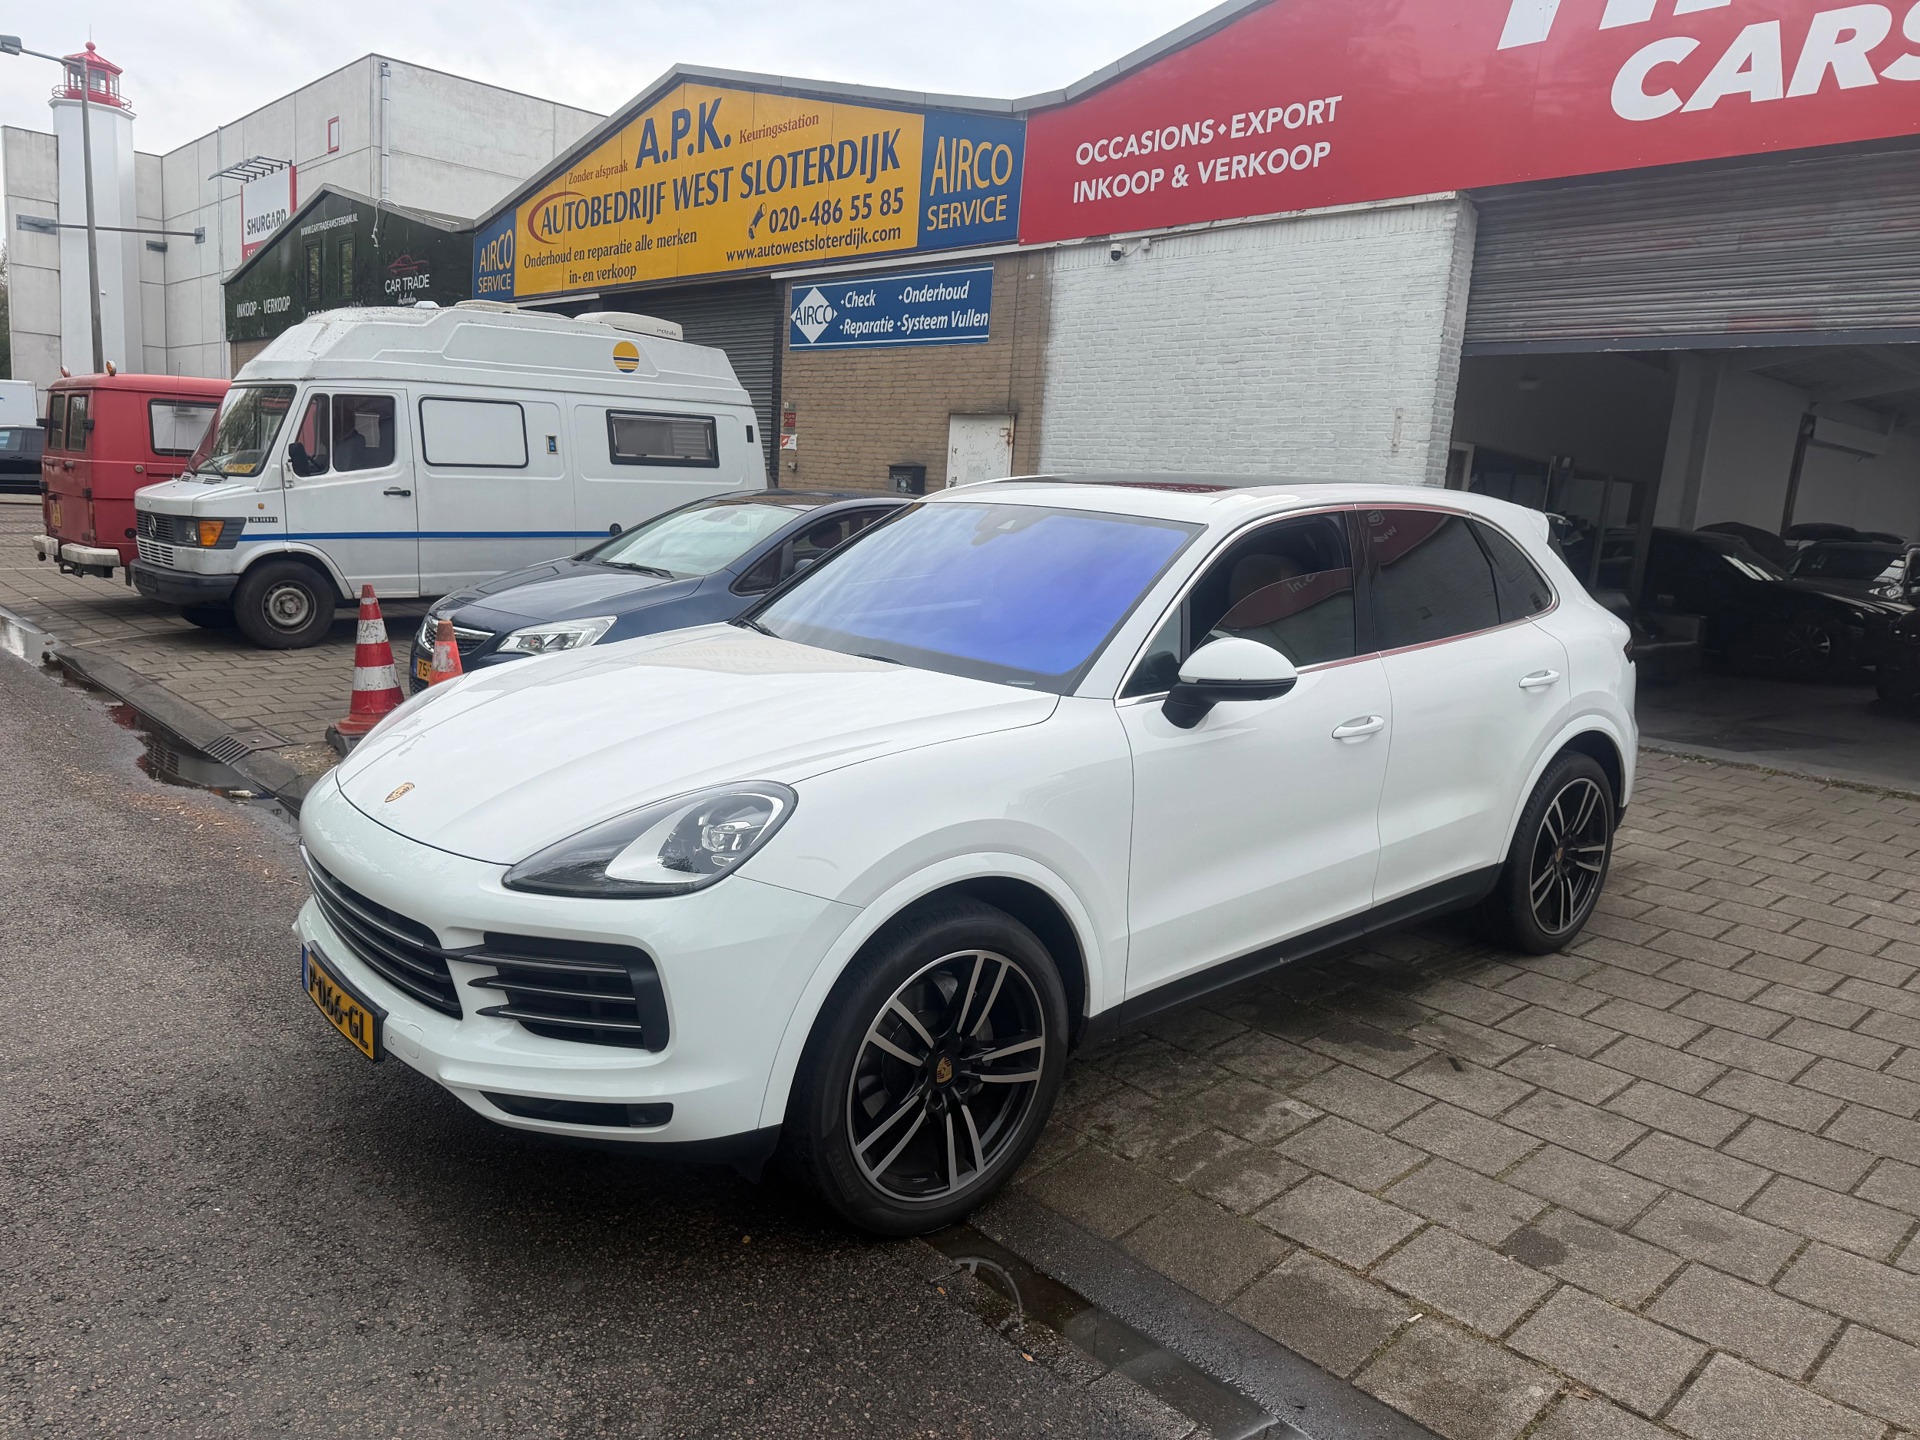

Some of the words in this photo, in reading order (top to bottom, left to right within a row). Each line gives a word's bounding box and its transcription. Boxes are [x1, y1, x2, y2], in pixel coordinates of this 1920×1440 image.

[635, 97, 732, 169] A.P.K.
[739, 114, 819, 144] Keuringsstation
[1075, 118, 1215, 166] OCCASIONS
[1230, 95, 1343, 139] EXPORT
[568, 167, 593, 185] Zonder
[595, 159, 628, 180] afspraak
[929, 136, 1013, 197] AIRCO
[1073, 168, 1165, 204] INKOOP
[1171, 164, 1189, 189] &
[1197, 141, 1331, 184] VERKOOP
[540, 181, 666, 237] AUTOBEDRIJF
[673, 167, 734, 211] WEST
[740, 128, 901, 199] SLOTERDIJK
[246, 208, 287, 236] SHURGARD
[769, 198, 843, 234] 020-486
[849, 193, 873, 221] 55
[879, 187, 904, 216] 85
[926, 194, 1008, 231] SERVICE
[479, 229, 514, 274] AIRCO
[524, 247, 572, 269] Onderhoud
[574, 249, 585, 261] en
[587, 240, 632, 262] reparatie
[635, 234, 653, 252] alle
[656, 228, 698, 249] merken
[726, 227, 901, 262] www.autowestsloterdijk.com
[385, 279, 401, 293] CAR
[402, 273, 430, 290] TRADE
[478, 273, 512, 294] SERVICE
[596, 264, 637, 281] verkoop
[845, 289, 877, 308] Check
[903, 280, 971, 304] Onderhoud
[236, 301, 257, 318] INKOOP
[263, 296, 291, 314] VERKOOP
[795, 304, 834, 326] AIRCO
[843, 316, 894, 338] Reparatie
[901, 313, 948, 335] Systeem
[951, 309, 989, 328] Vullen
[418, 660, 432, 677] 75-
